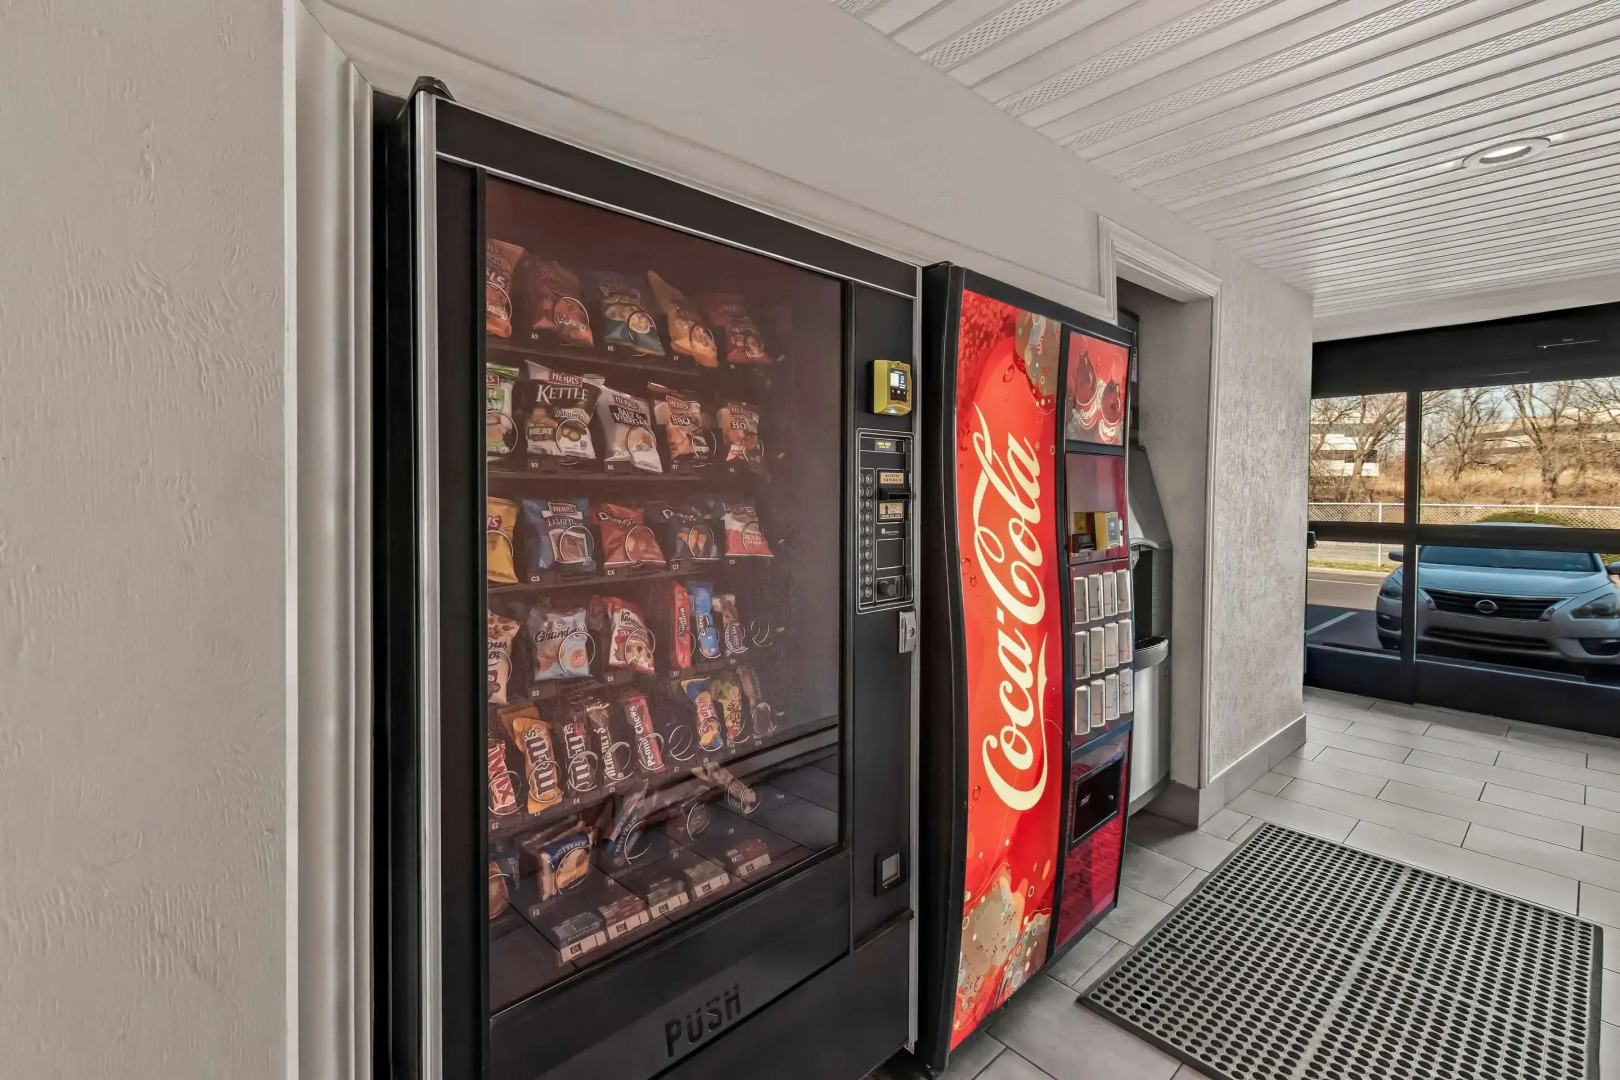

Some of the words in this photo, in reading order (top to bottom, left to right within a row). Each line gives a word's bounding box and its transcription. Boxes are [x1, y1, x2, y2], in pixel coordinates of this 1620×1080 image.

[535, 383, 589, 406] KETTLE
[971, 401, 1048, 811] Coca-Cola
[628, 705, 644, 735] Chews
